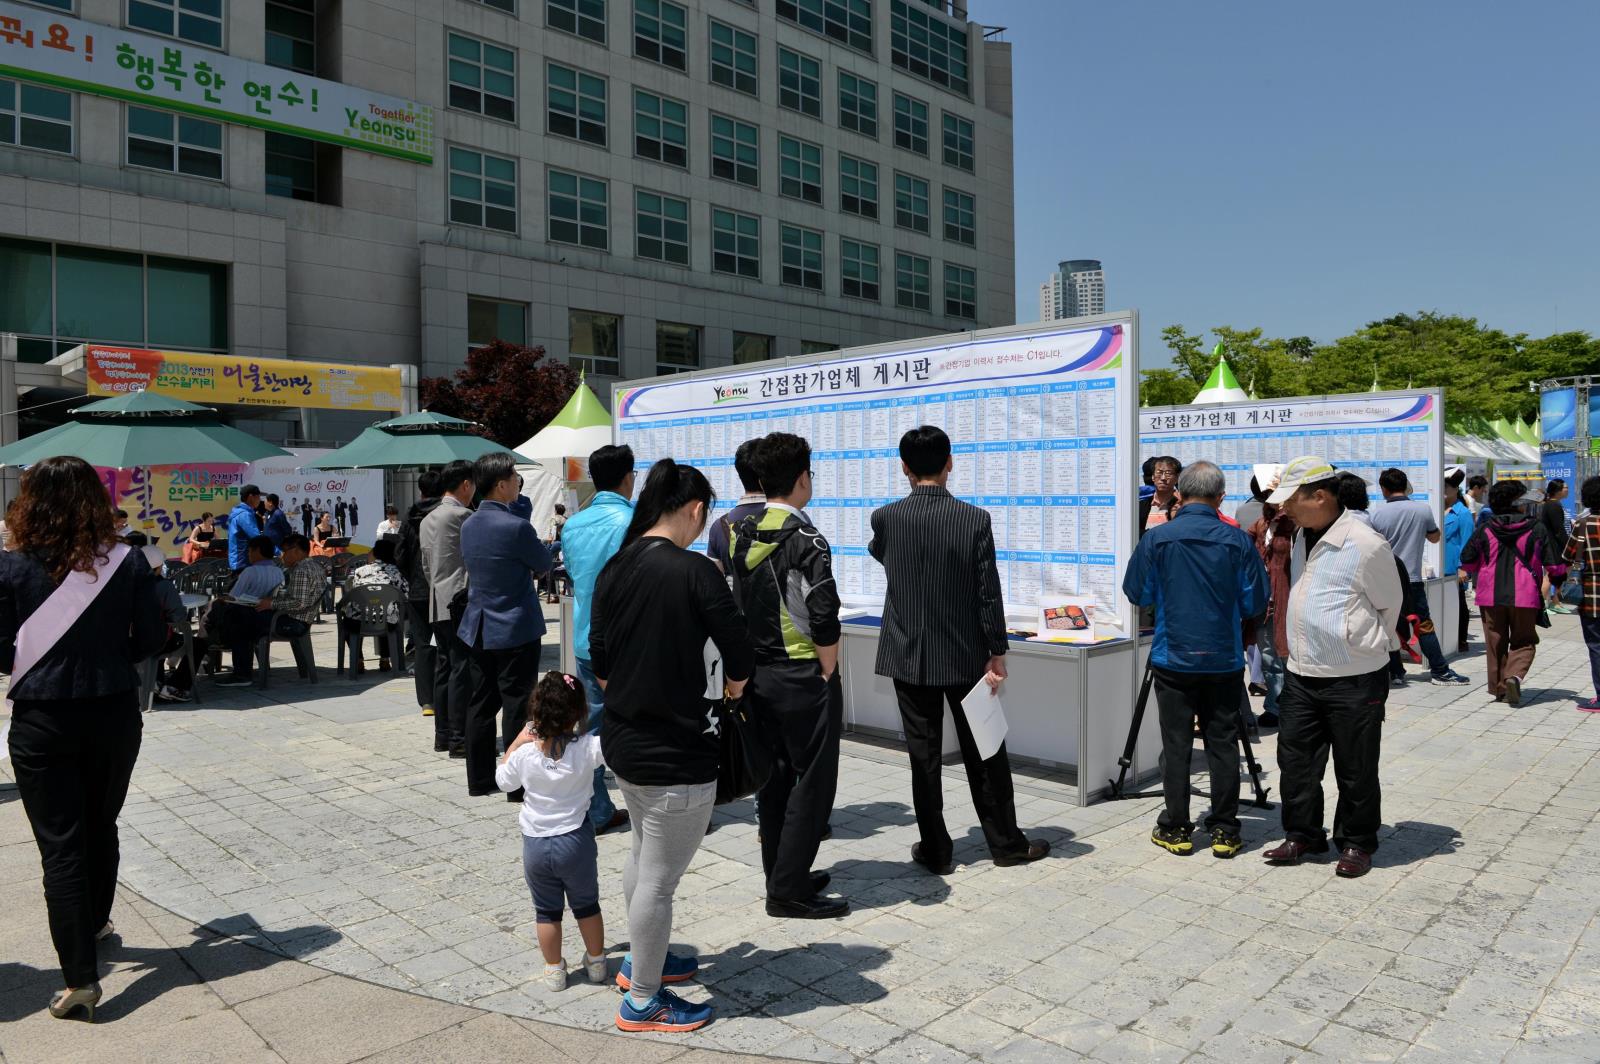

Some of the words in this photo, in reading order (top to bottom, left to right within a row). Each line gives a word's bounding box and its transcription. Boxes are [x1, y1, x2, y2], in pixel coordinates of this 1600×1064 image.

[116, 42, 226, 104] 행복한
[243, 81, 319, 115] 연수!
[368, 103, 416, 124] Together
[344, 107, 416, 141] Yeonsu
[159, 362, 190, 376] 2013
[759, 365, 861, 398] 간접참가업체
[873, 357, 932, 385] 게시판
[157, 375, 216, 390] 연수일자리
[713, 385, 748, 401] Yeonsu
[1149, 411, 1236, 430] 간접참가업체
[1246, 408, 1293, 425] 게시판
[168, 468, 210, 486] 2013
[210, 471, 244, 486] 상반기
[304, 481, 322, 493] Go!
[326, 479, 349, 493] Go!
